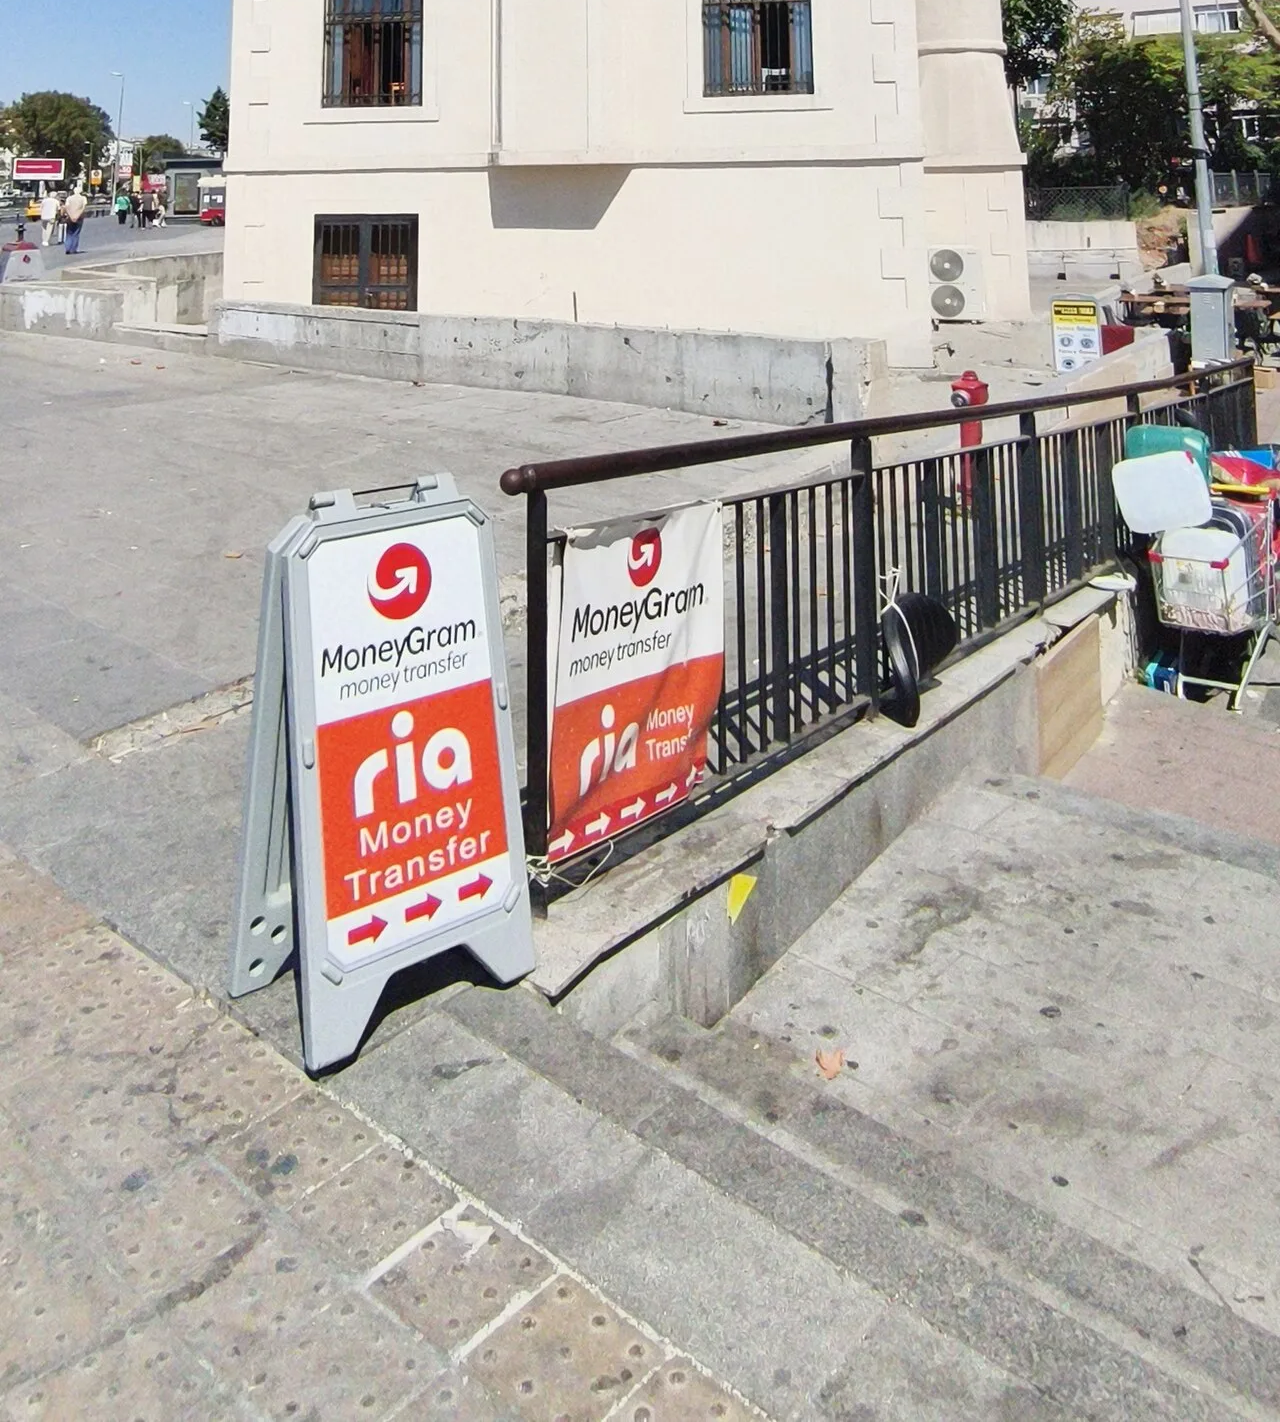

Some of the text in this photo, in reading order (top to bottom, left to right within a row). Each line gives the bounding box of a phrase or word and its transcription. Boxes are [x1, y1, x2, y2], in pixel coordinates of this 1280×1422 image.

[571, 581, 704, 643] MoneyGram
[320, 618, 477, 678] MoneyGram
[339, 650, 468, 701] money transfer
[569, 630, 672, 678] money transfer
[646, 703, 695, 732] Money
[352, 710, 474, 819] ria
[578, 704, 641, 798] ria
[358, 797, 475, 857] Money
[344, 828, 491, 902] Transfer
